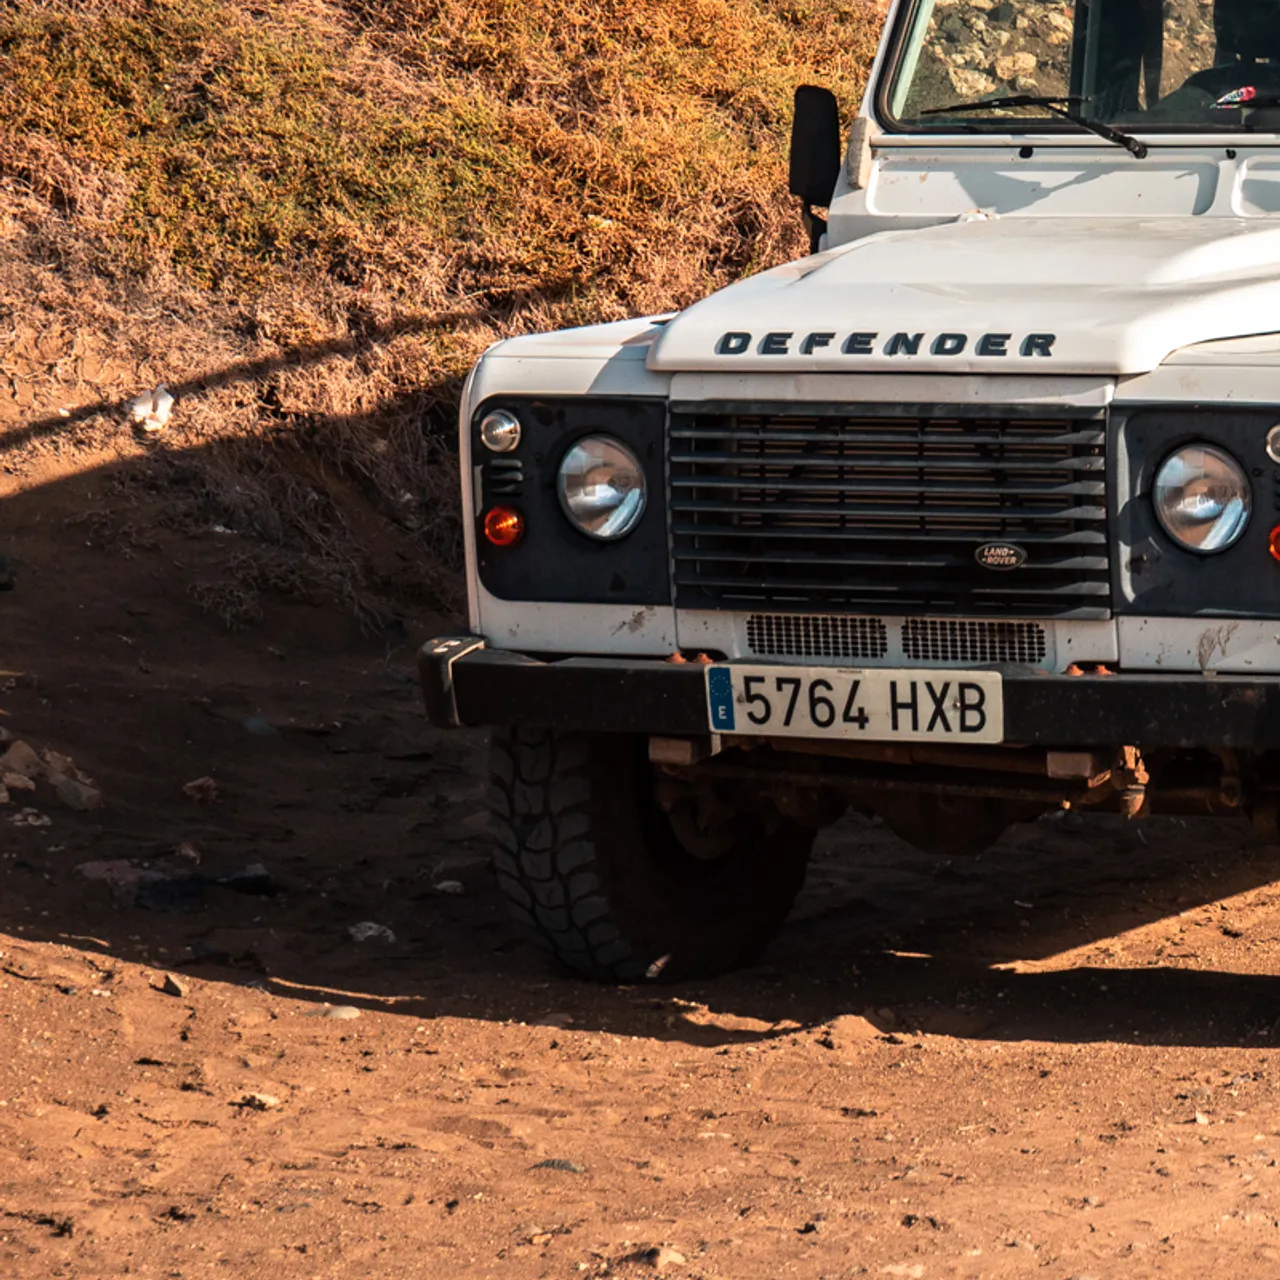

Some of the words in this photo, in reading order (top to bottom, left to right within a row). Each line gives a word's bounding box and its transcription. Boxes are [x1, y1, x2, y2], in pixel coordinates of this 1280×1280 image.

[714, 331, 1057, 357] DEFENDER
[983, 547, 1010, 557] LAND
[987, 556, 1017, 565] ROVER
[718, 705, 727, 719] E
[743, 675, 869, 730] 5764
[889, 680, 987, 734] HXB
